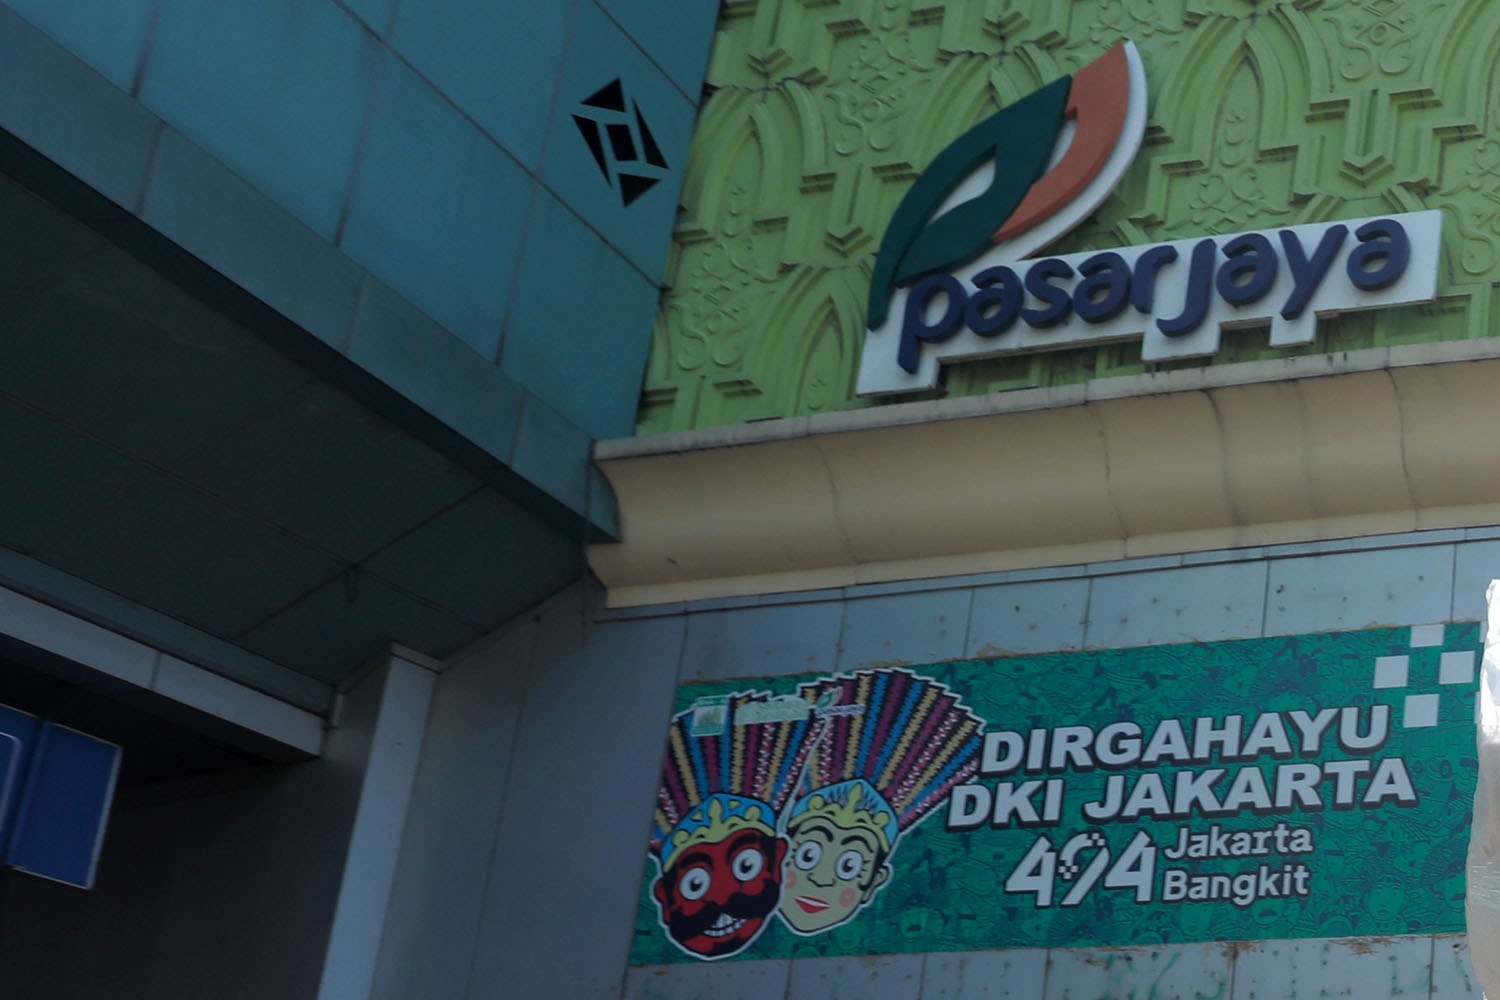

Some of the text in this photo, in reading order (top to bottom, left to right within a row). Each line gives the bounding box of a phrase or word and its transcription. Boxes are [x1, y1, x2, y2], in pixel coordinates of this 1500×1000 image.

[899, 217, 1411, 375] pasarjaya
[980, 705, 1391, 775] DIRGAHAYU
[948, 756, 1417, 828] DKI JAKARTA
[1006, 832, 1154, 907] 494
[1165, 823, 1314, 863] Jakarta
[1162, 861, 1310, 907] Bangkit
